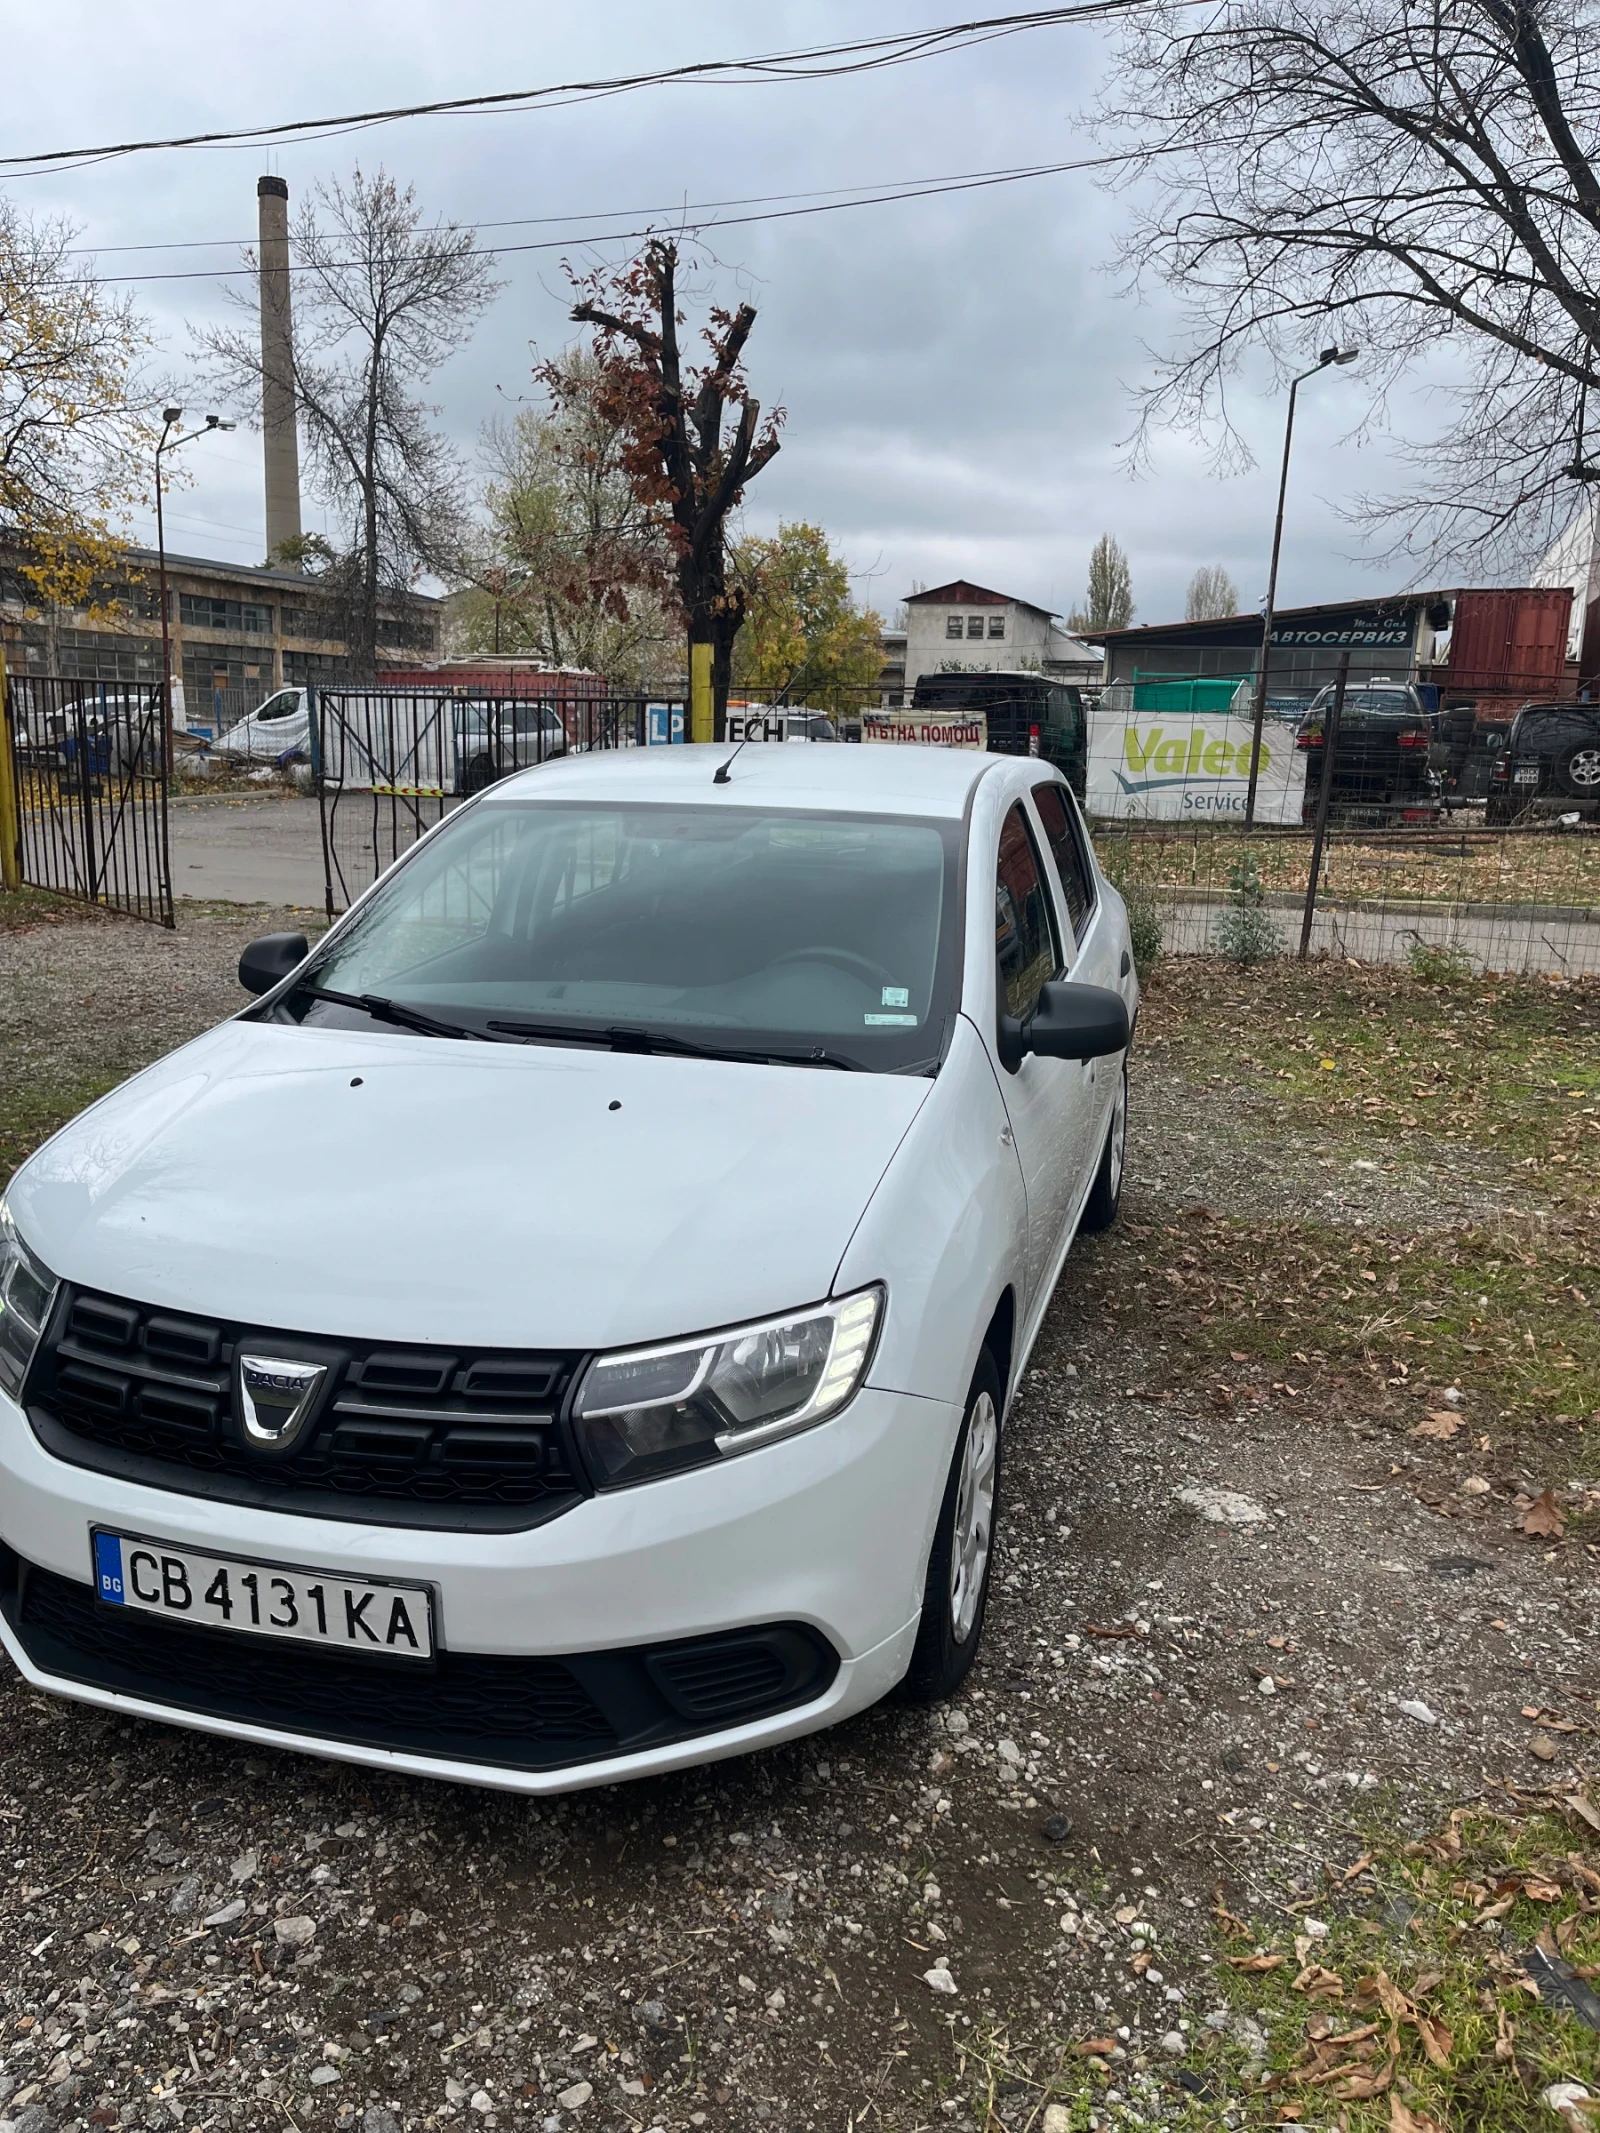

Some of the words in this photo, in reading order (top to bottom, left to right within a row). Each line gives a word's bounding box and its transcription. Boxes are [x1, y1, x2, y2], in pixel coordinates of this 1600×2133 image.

[1353, 618, 1379, 628] Max
[1383, 618, 1407, 628] Gas
[1269, 631, 1408, 644] АВТОСЕРВИЗ
[725, 717, 784, 742] ECH
[866, 723, 916, 742] ПЪТНА
[921, 725, 980, 746] ПОМОЩ
[1124, 728, 1271, 776] Valeo
[247, 1369, 304, 1391] DACIA
[102, 1575, 122, 1593] BG
